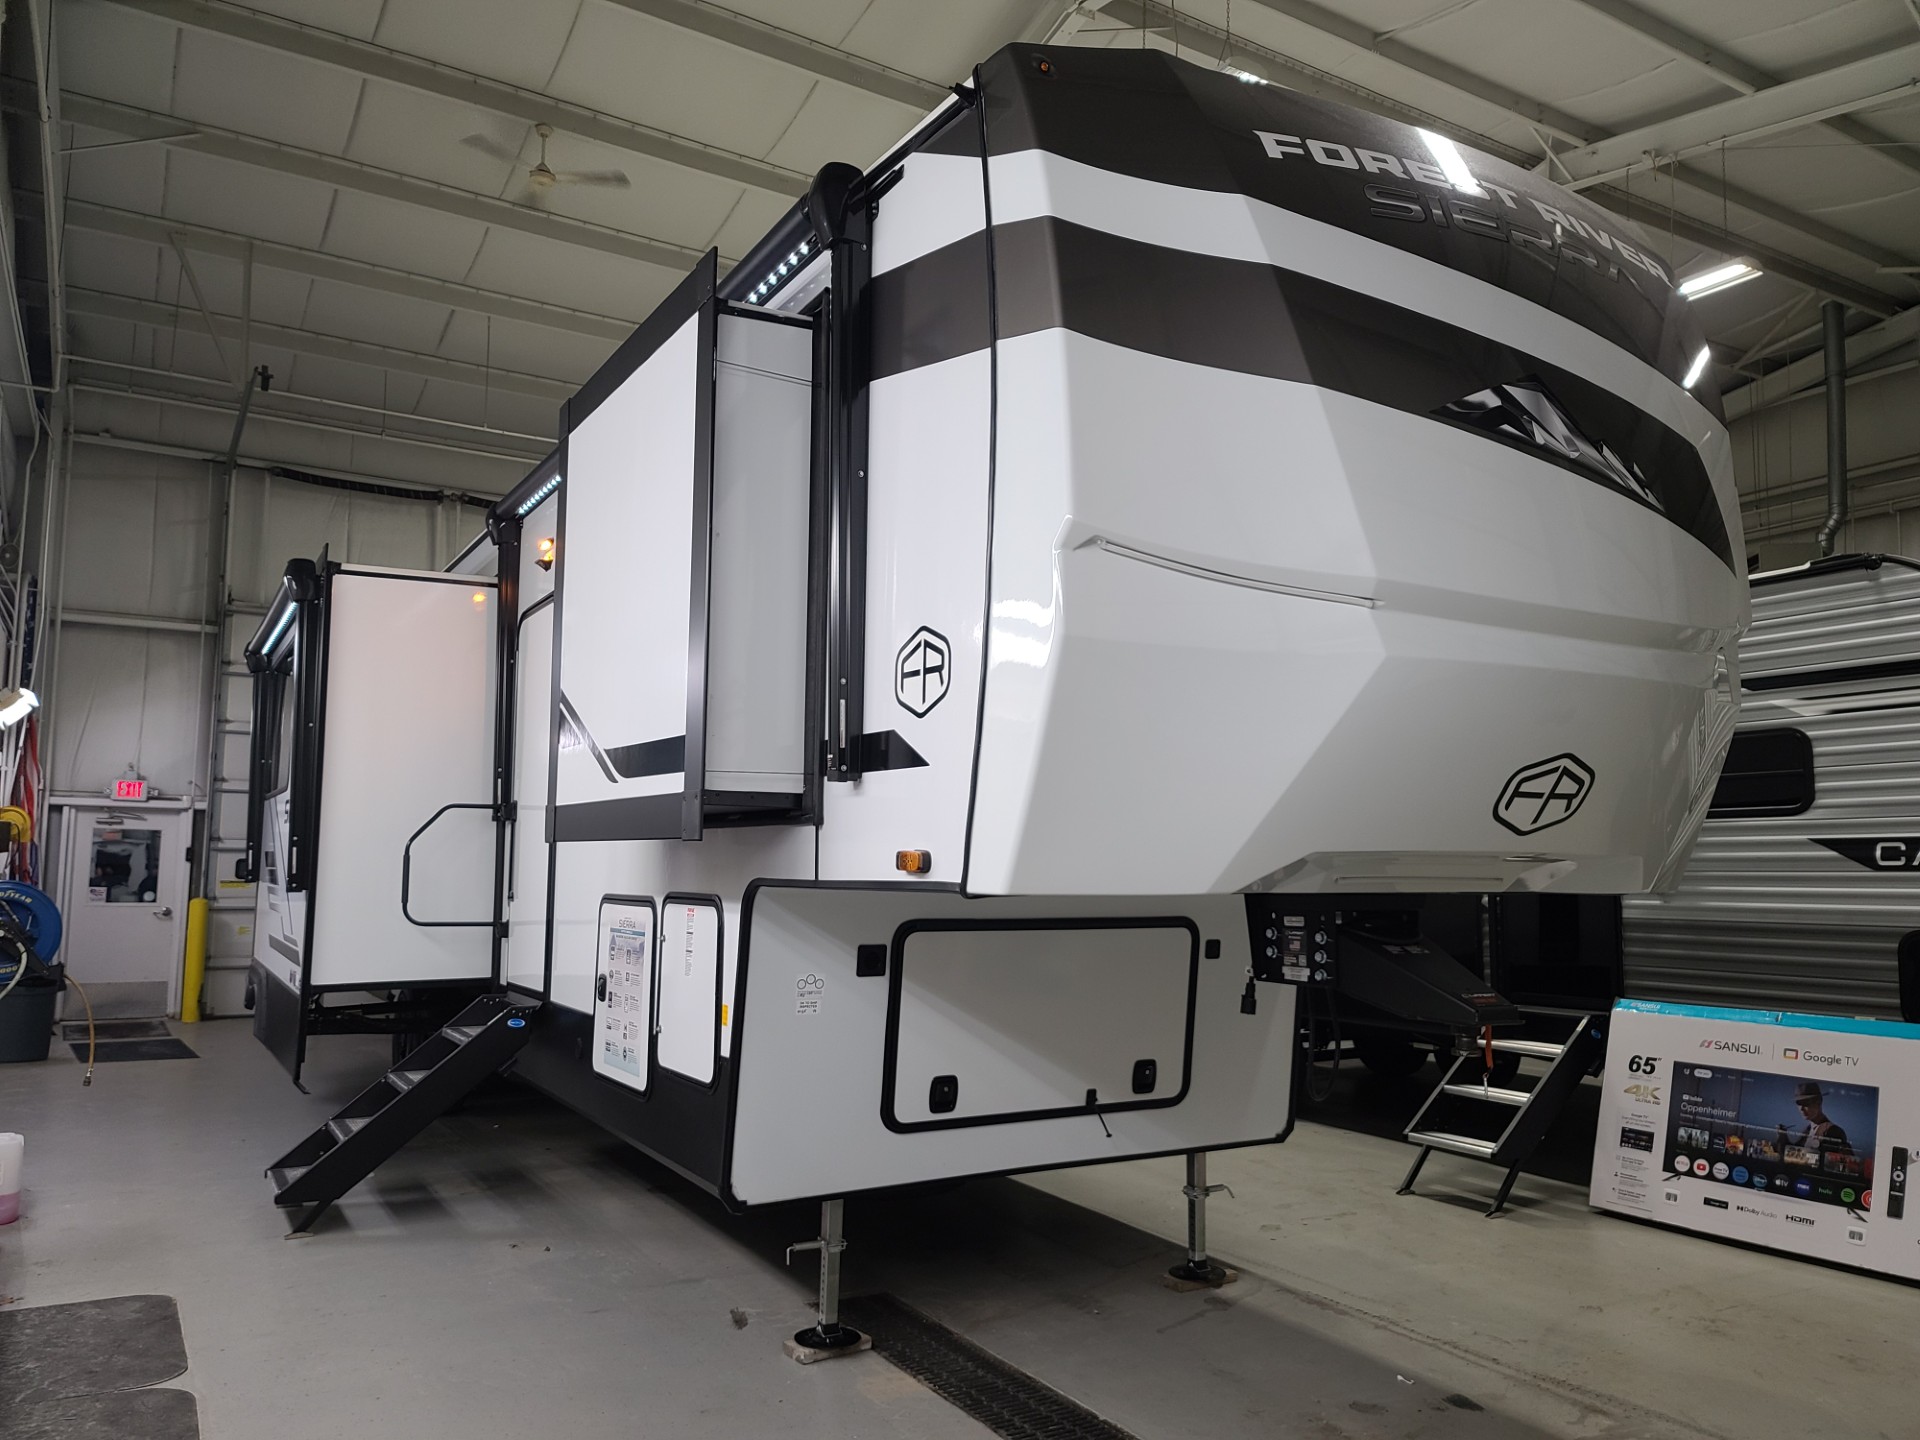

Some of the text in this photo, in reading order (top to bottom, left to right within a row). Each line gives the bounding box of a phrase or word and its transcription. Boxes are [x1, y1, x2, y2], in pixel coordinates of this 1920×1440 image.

[1363, 181, 1643, 294] SIERRA
[1527, 196, 1674, 290] RIVER
[116, 780, 144, 798] EXIT
[1875, 842, 1920, 866] C
[1714, 1040, 1860, 1067] SANSUI Google TV
[1624, 1084, 1661, 1100] 4K
[1680, 1101, 1737, 1118] Oppenheimer
[1818, 1186, 1833, 1195] hulu
[1744, 1205, 1778, 1219] Dolby Audio
